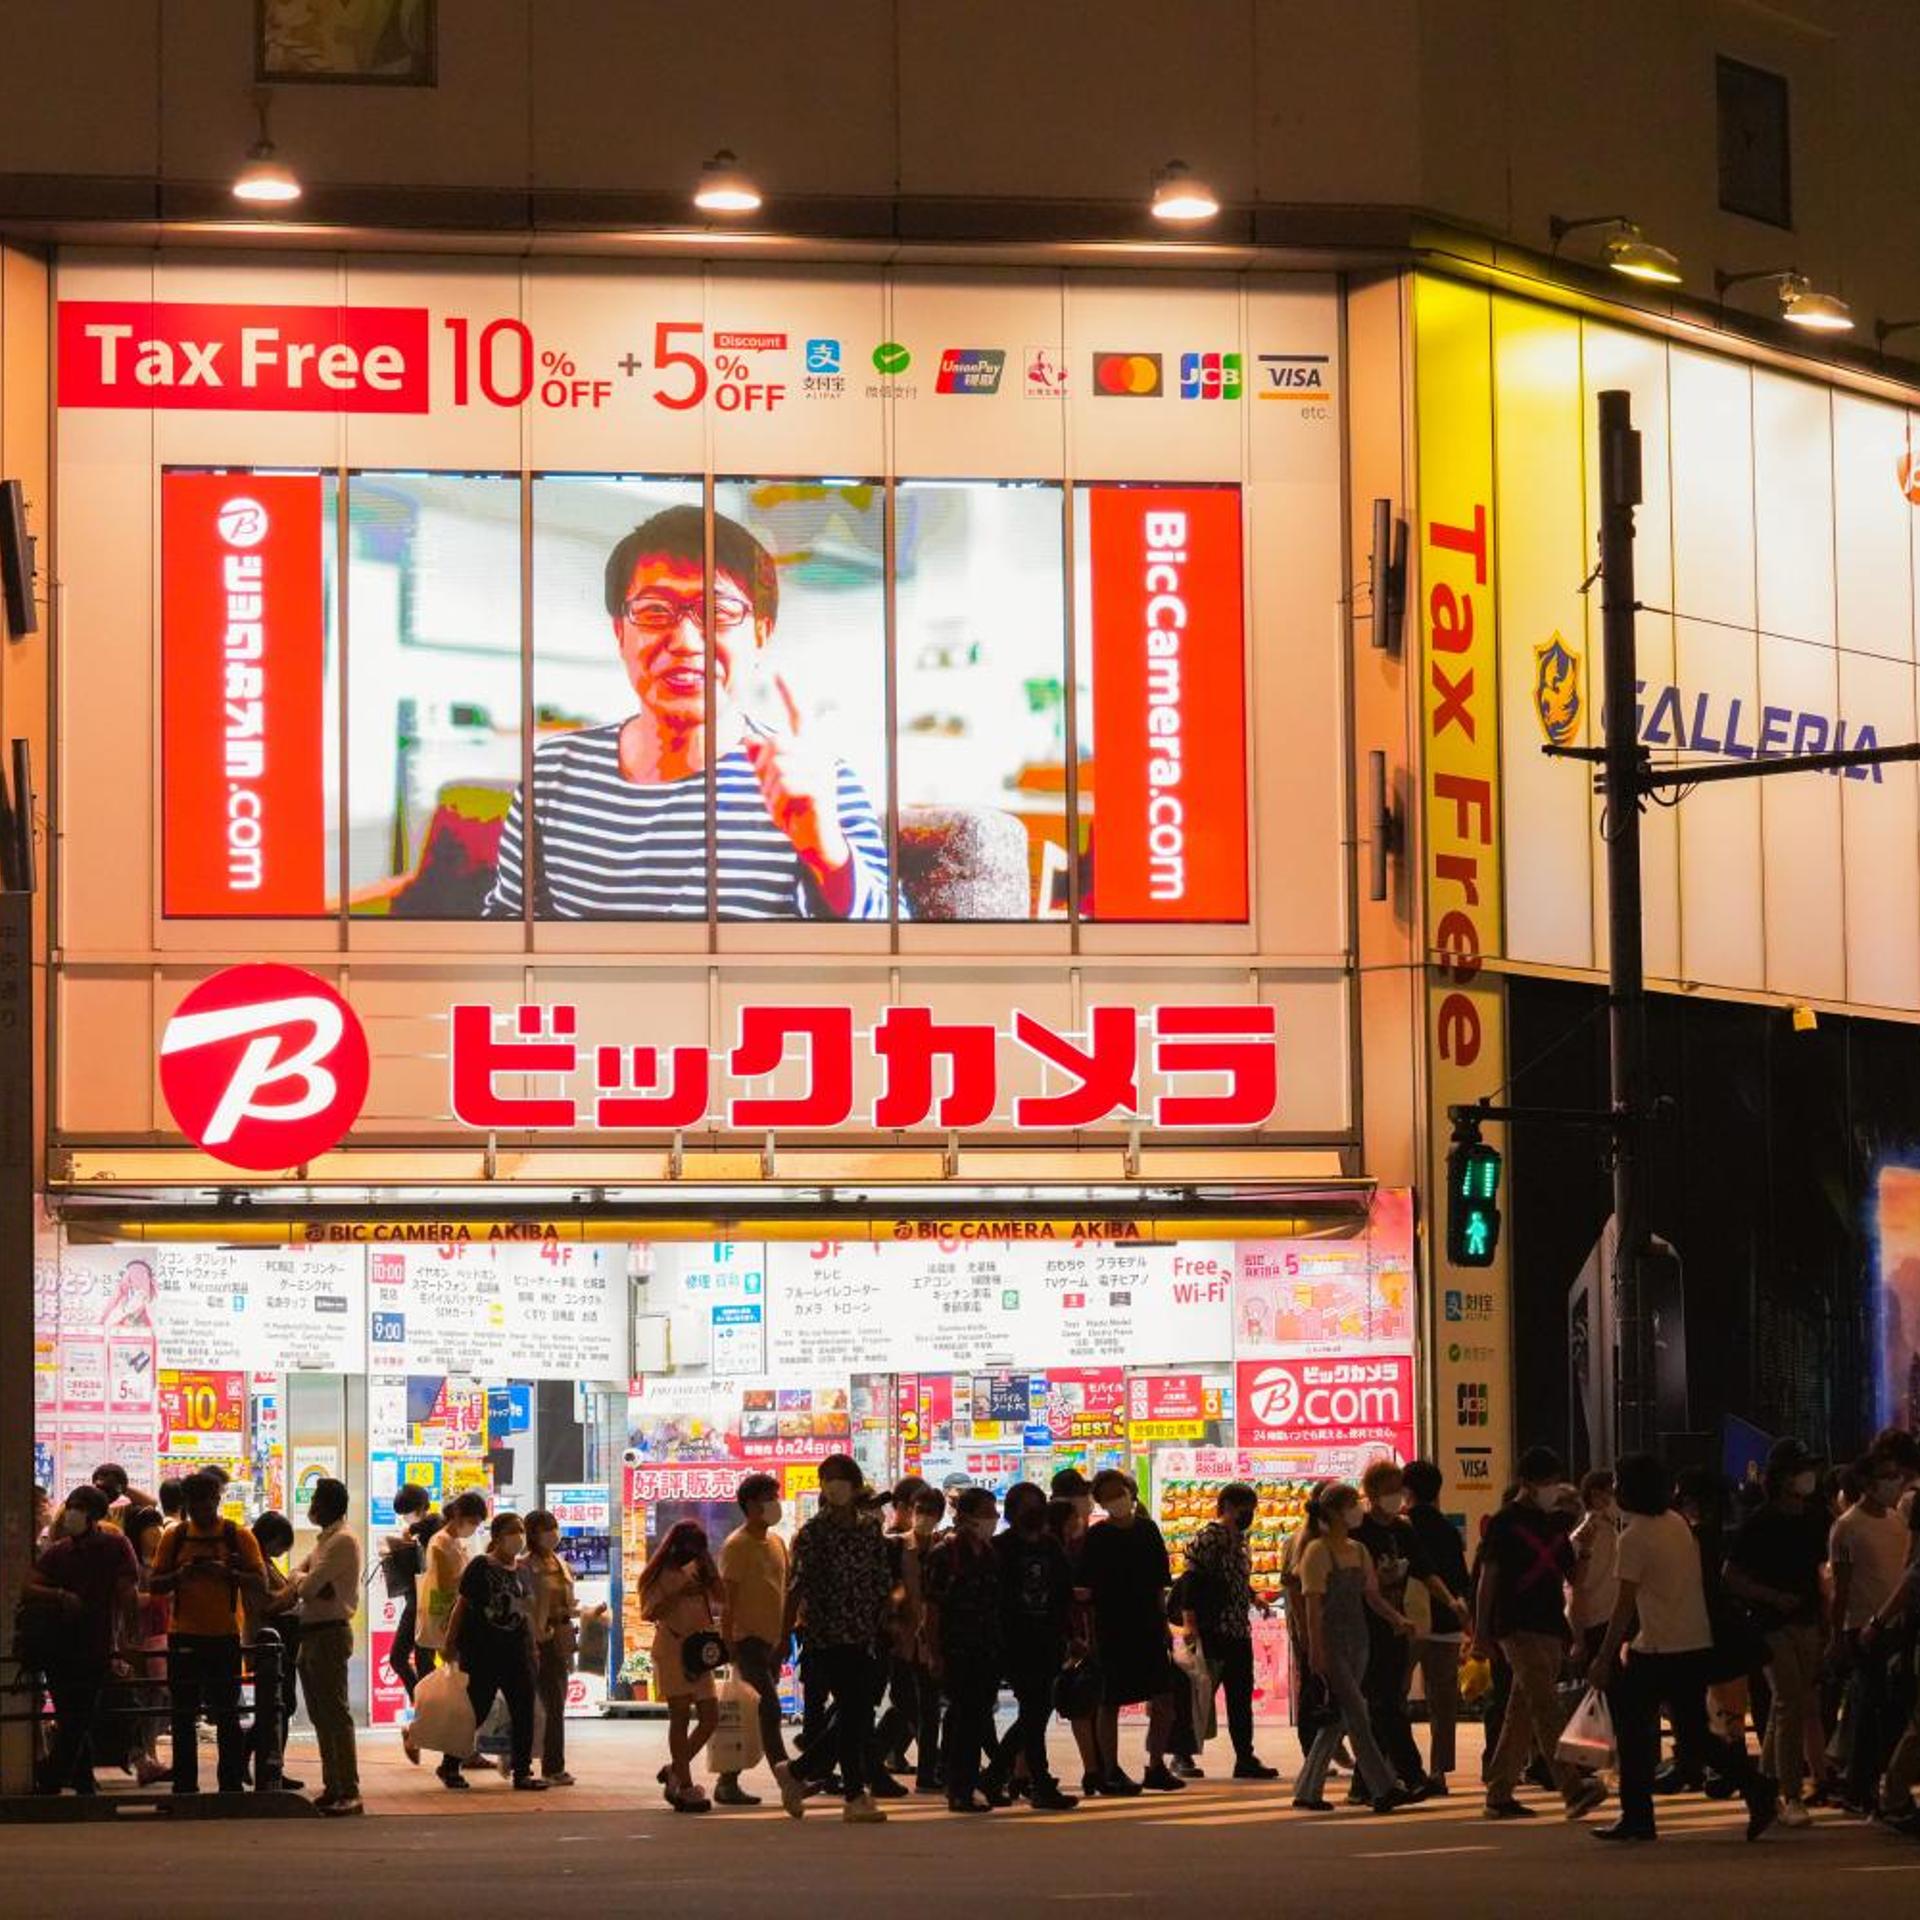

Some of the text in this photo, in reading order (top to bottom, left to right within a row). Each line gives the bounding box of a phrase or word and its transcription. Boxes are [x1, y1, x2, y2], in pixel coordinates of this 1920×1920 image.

[719, 334, 782, 349] Discount
[85, 323, 406, 391] Tax Free
[445, 318, 533, 407] 10
[654, 322, 708, 410] 5
[541, 351, 576, 377] %
[715, 354, 749, 381] %
[942, 359, 1000, 376] UnionPay
[802, 375, 846, 392] 支付宝
[1180, 368, 1240, 385] JCB
[1268, 368, 1322, 387] VISA
[541, 380, 612, 408] OFF
[715, 384, 786, 412] OFF
[1301, 405, 1331, 419] etc.
[1145, 512, 1188, 900] BicCamera.com
[1602, 680, 1883, 784] ALLERIA
[1430, 505, 1492, 1067] Tax Free
[451, 1004, 1278, 1128] ビックカメラ
[330, 1223, 559, 1241] BIC CAMERA AKIBA
[918, 1221, 1139, 1239] BIC CAMERA AKIBA
[1173, 1256, 1218, 1275] Free
[1173, 1282, 1225, 1304] Wi-Fi
[795, 1303, 823, 1315] カメラ
[1302, 1363, 1399, 1385] ビックカメラ
[182, 1385, 218, 1431] 10
[1296, 1387, 1400, 1425] .com
[1071, 1421, 1112, 1439] BEST
[1460, 1459, 1489, 1478] VISA
